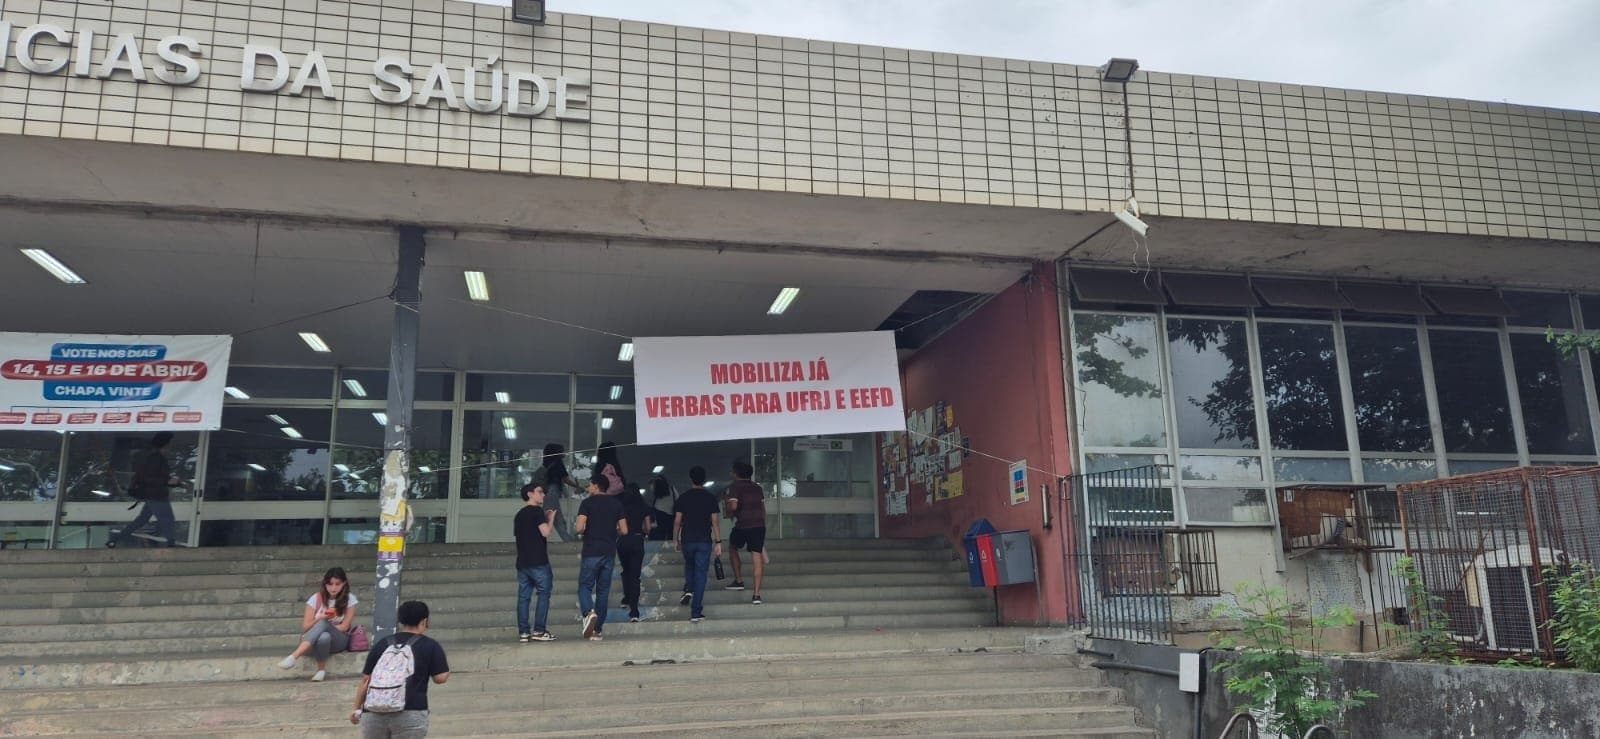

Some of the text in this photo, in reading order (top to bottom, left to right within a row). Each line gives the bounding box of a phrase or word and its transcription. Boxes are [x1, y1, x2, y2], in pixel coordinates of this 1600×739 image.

[0, 20, 592, 122] CIAS DA SAÚDE
[61, 348, 158, 359] VOTE NOS DIAS
[13, 363, 200, 377] 14, 15 E 16 DE ABRIL
[710, 356, 830, 384] MOBILIZA JÁ
[55, 385, 152, 396] CHAPA VINTE
[644, 386, 895, 419] VERBAS PARA UFRJ E EEFD
